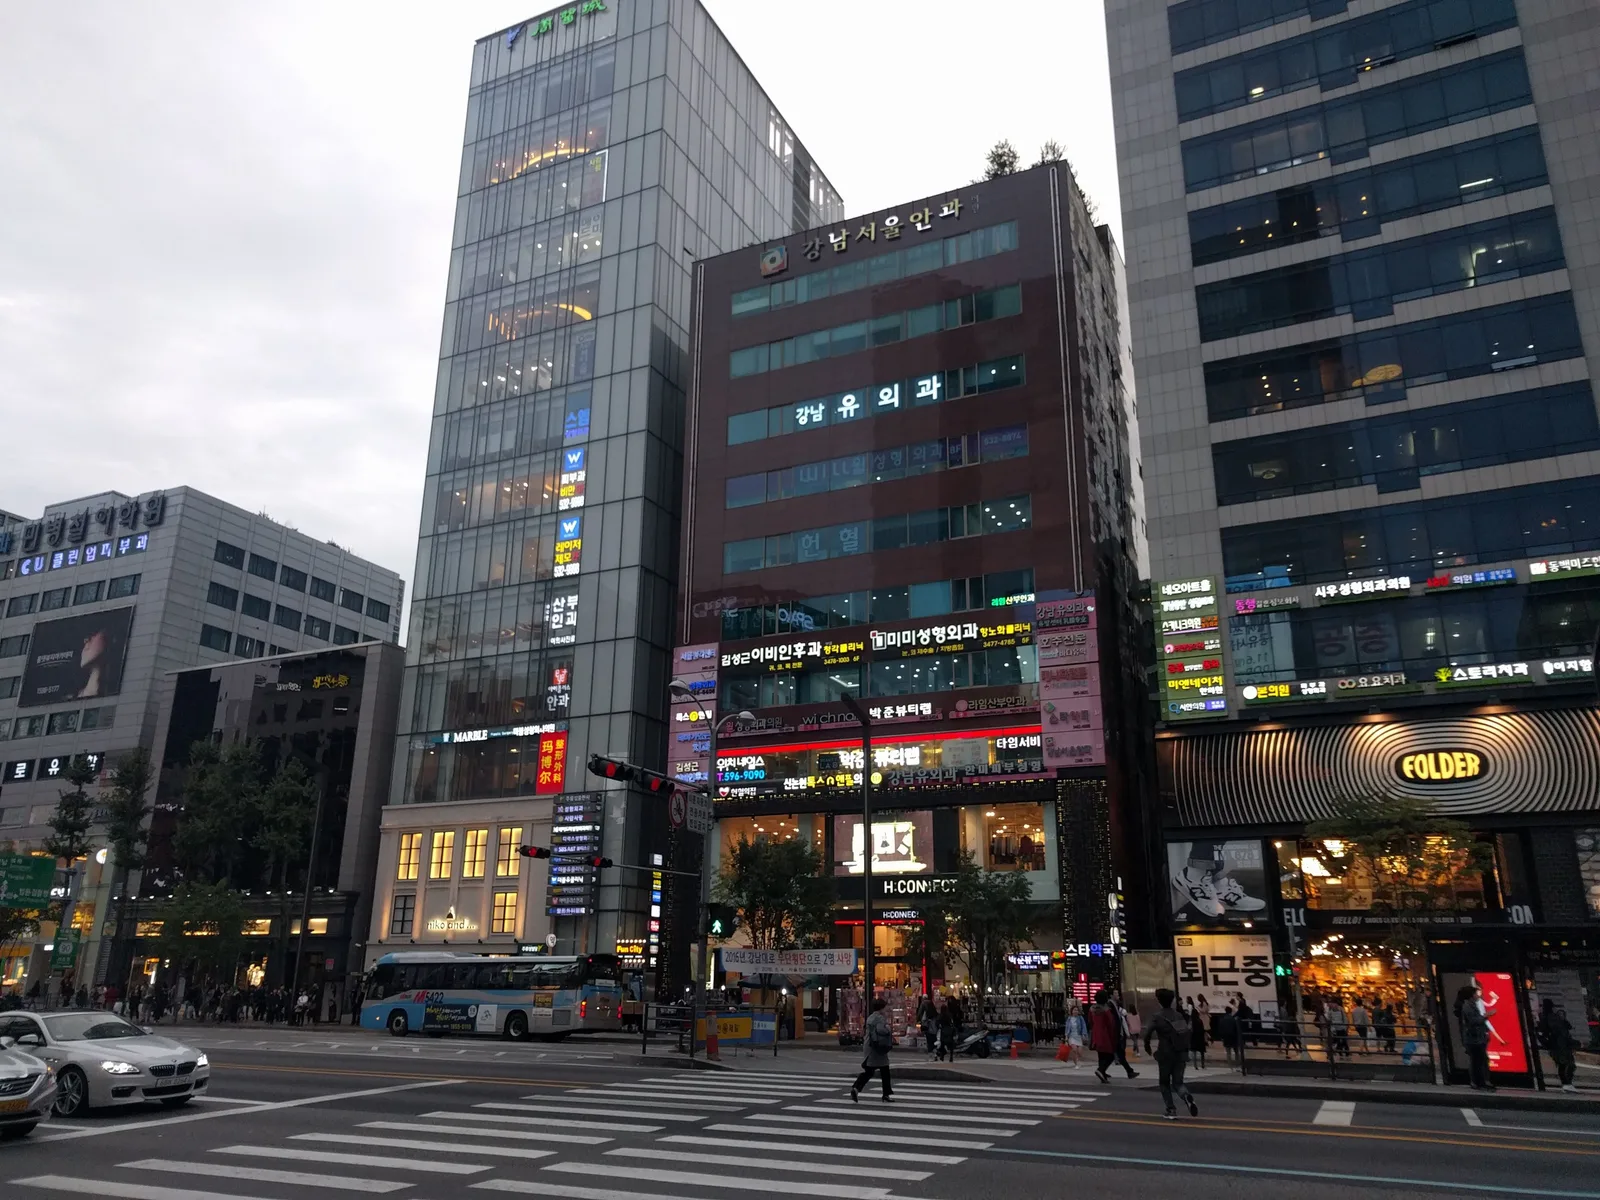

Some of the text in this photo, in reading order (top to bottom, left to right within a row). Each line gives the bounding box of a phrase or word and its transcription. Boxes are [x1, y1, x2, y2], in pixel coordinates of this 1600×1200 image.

[802, 198, 963, 260] 강남서울안과
[796, 402, 825, 425] 강남
[555, 538, 582, 552] 레이저
[21, 556, 44, 576] CU
[1314, 576, 1411, 598] 시우성형외과의원
[887, 623, 979, 647] 미미성형외과
[721, 652, 751, 667] 김성근
[751, 641, 823, 664] 이비인후과
[1453, 663, 1528, 681] 스토리치과
[869, 702, 932, 719] 박준뷰티랩
[453, 729, 489, 743] MARBLE
[552, 739, 565, 783] 整形外科
[676, 763, 699, 773] 김성근
[1402, 752, 1480, 780] FOLDER
[716, 769, 766, 782] T.596-9090
[427, 919, 446, 930] niko
[447, 917, 465, 930] and
[616, 944, 643, 954] Fun City
[1065, 943, 1115, 957] 스타약국
[1180, 954, 1273, 988] 퇴근중
